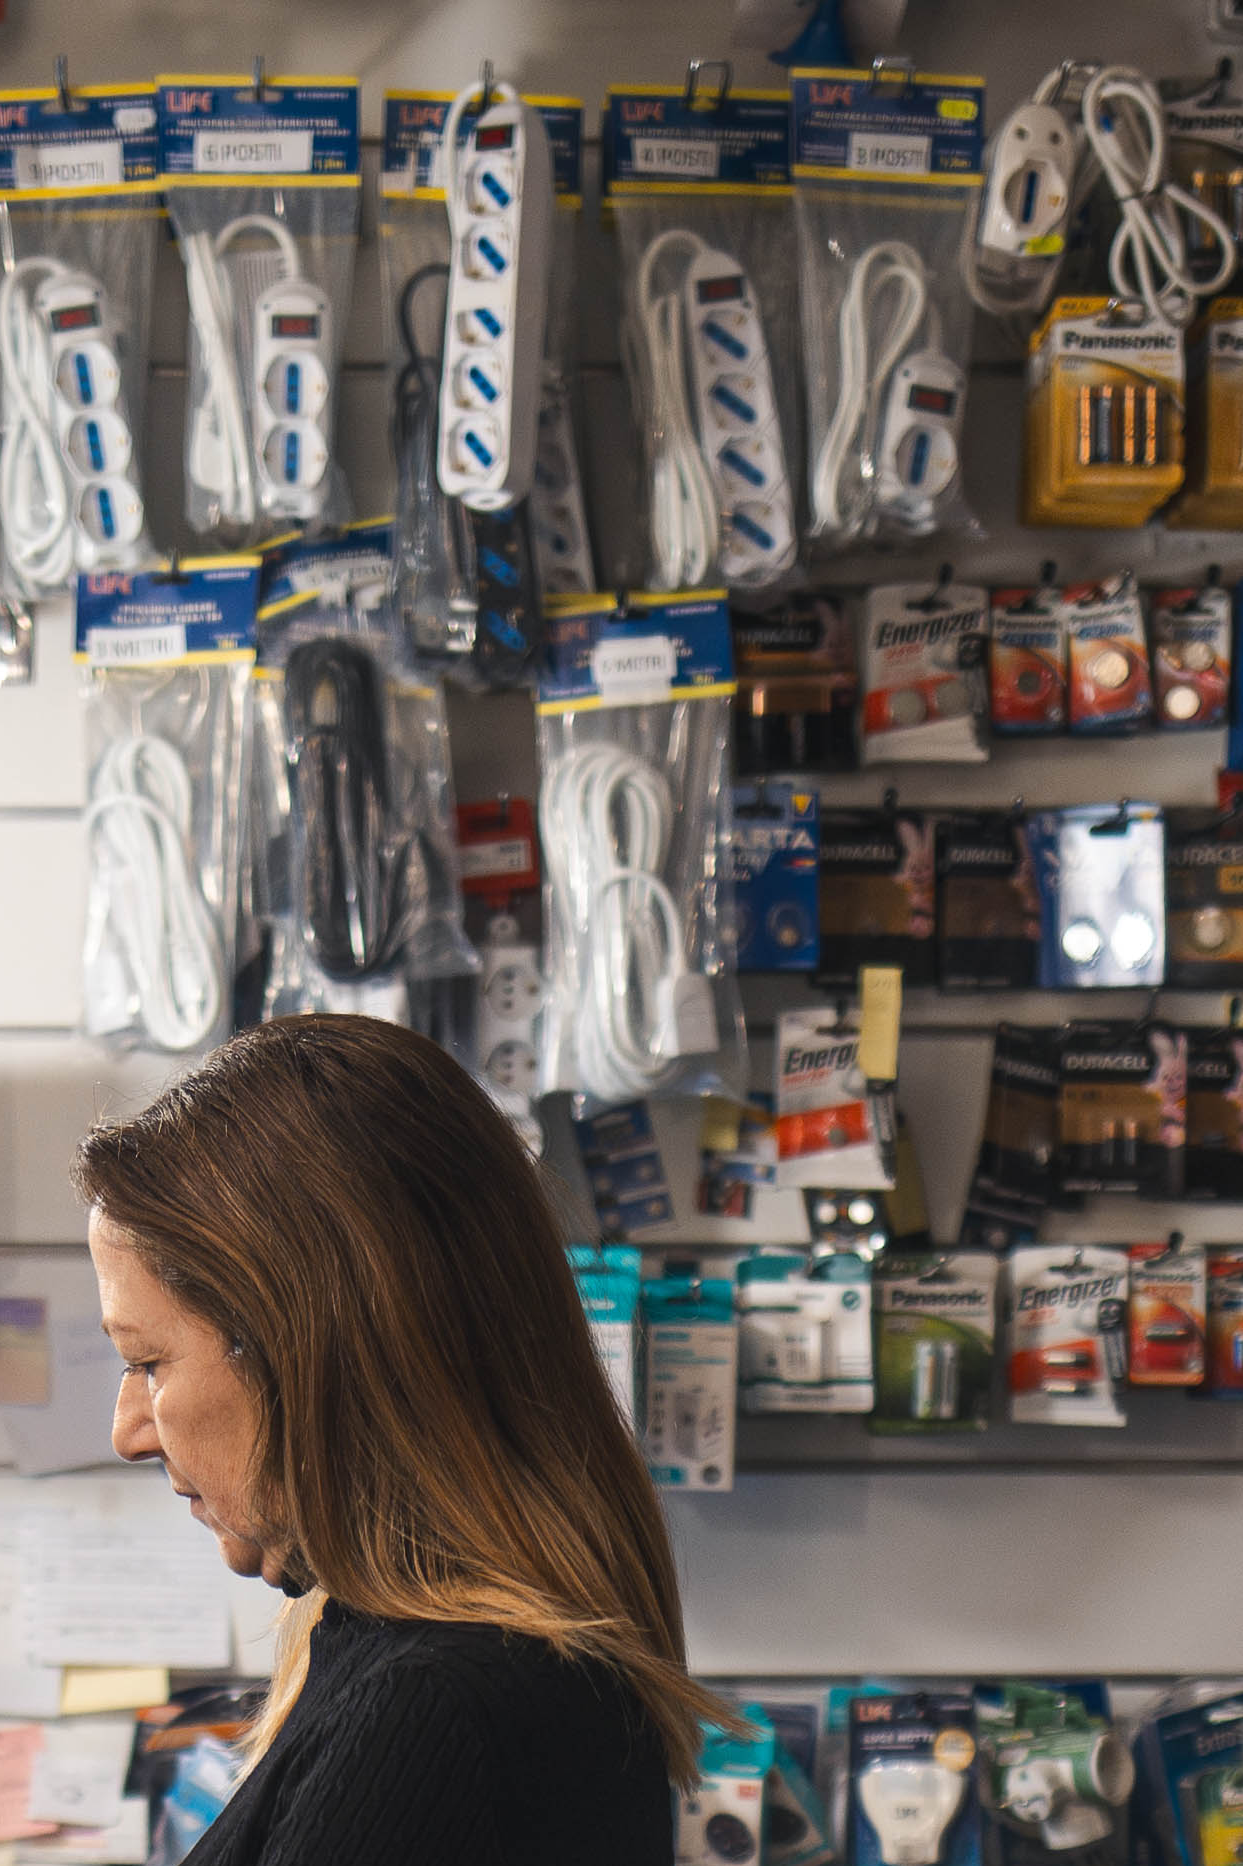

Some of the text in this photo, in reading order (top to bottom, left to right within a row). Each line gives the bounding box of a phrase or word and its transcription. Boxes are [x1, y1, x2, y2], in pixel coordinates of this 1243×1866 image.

[1062, 330, 1178, 351] Panasonic
[876, 609, 985, 650] Energizer
[728, 827, 815, 849] ARTA
[783, 1040, 860, 1075] Energi
[1064, 1055, 1150, 1071] DURACELL
[1195, 1062, 1231, 1078] CELL
[891, 1289, 987, 1307] Panasonic
[1017, 1275, 1123, 1311] Energizer
